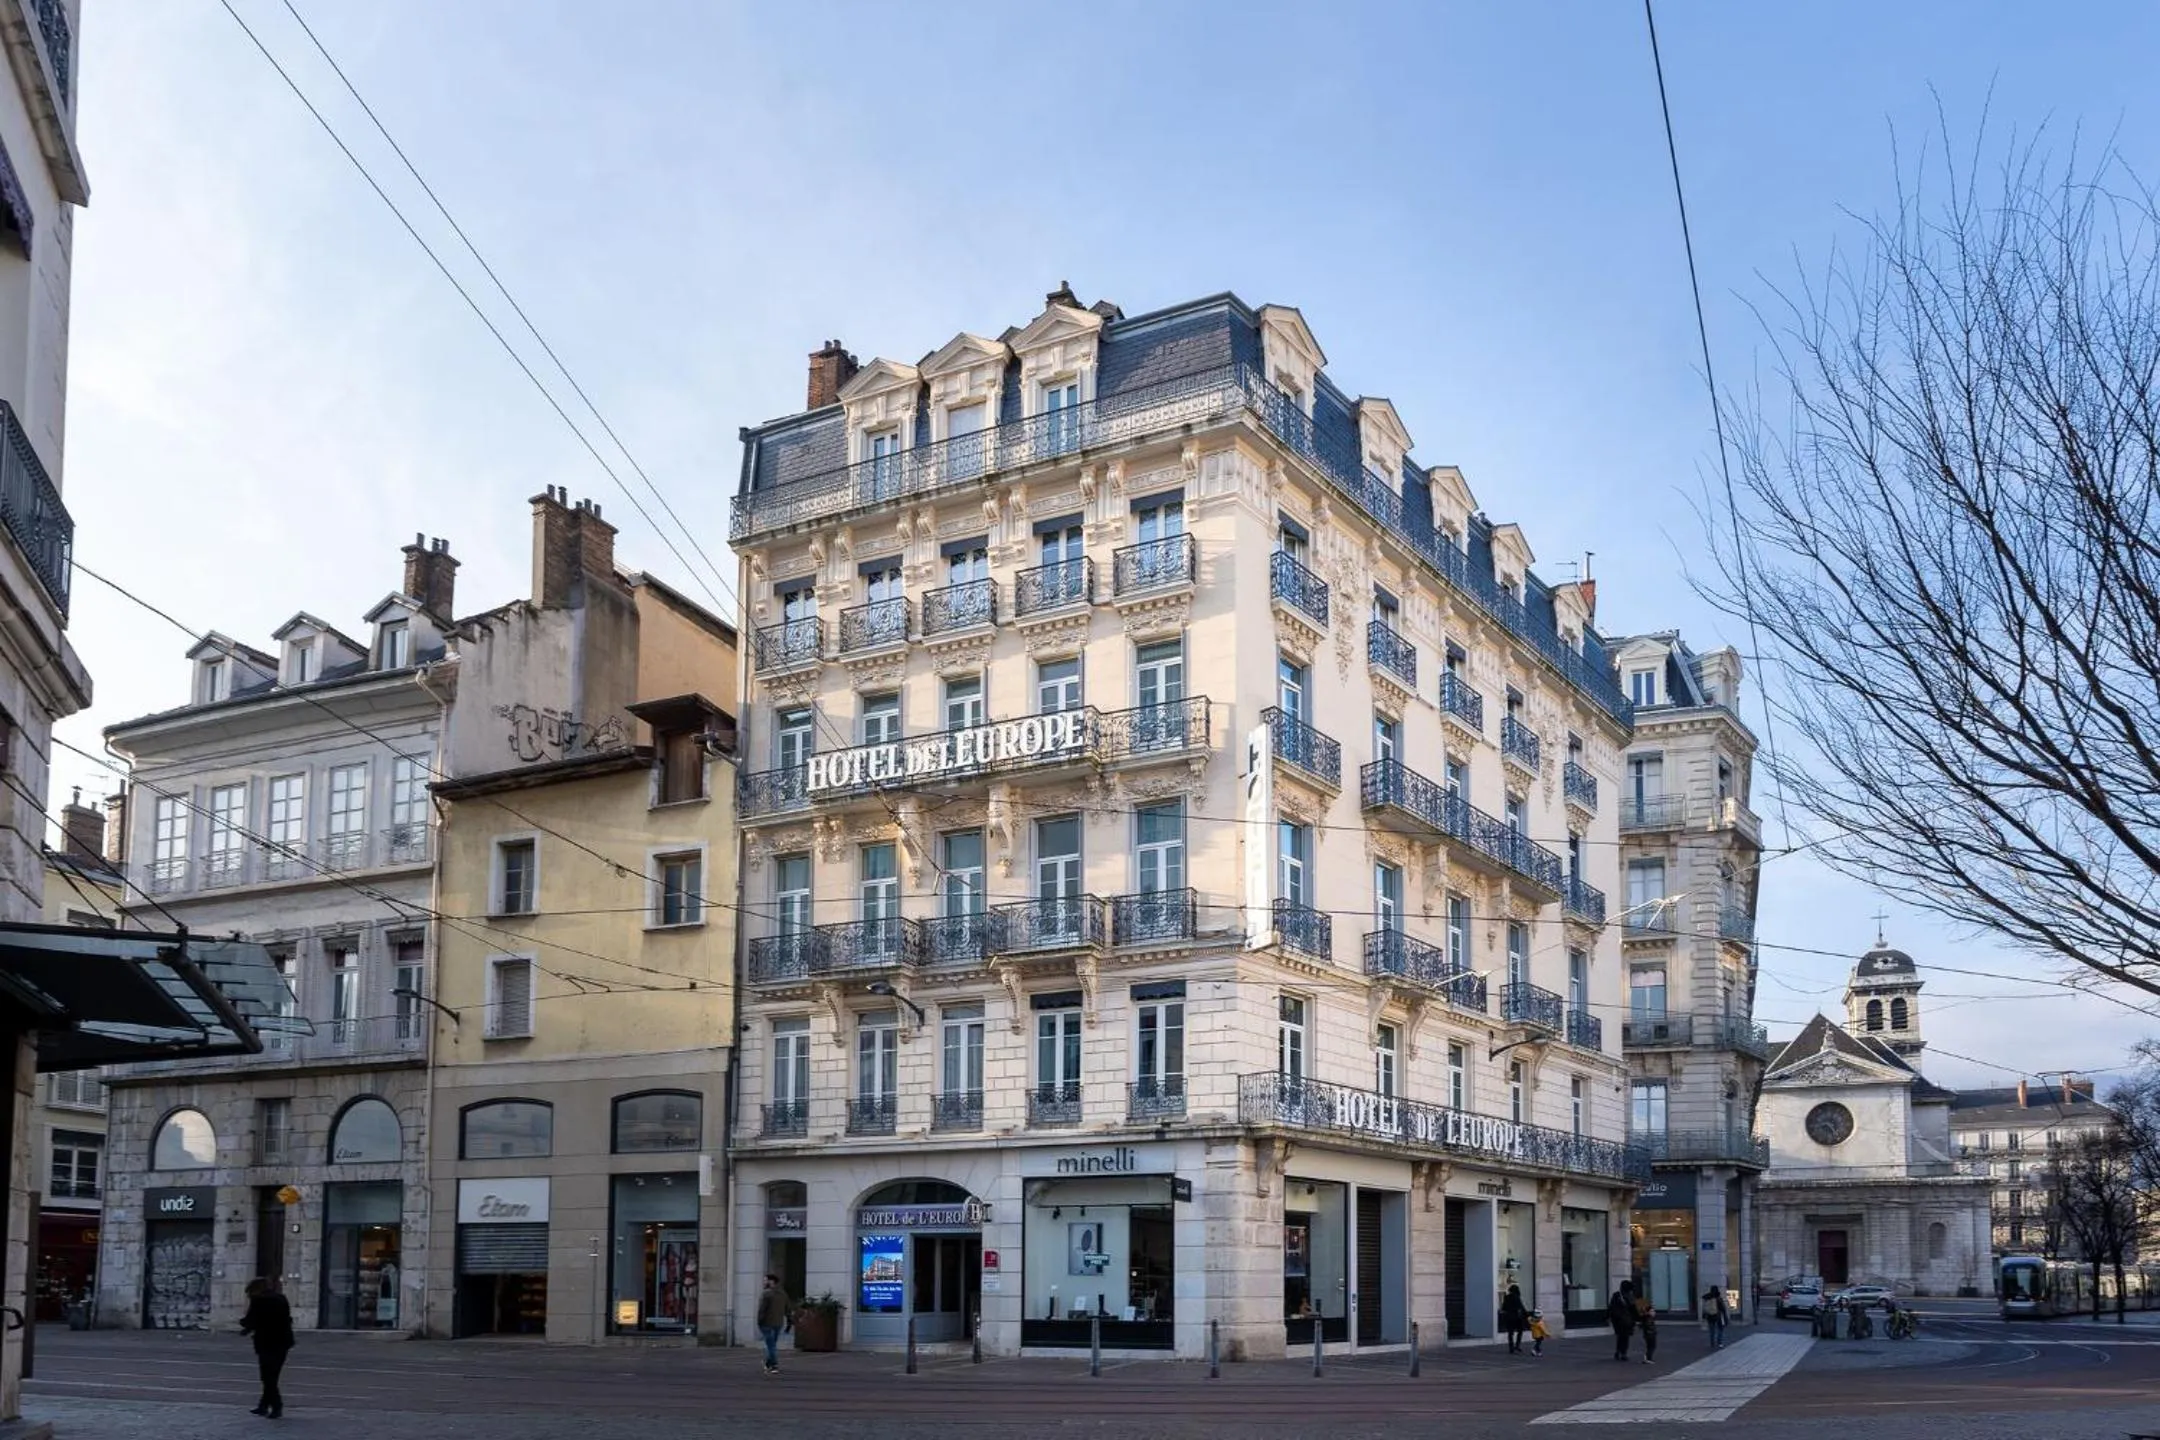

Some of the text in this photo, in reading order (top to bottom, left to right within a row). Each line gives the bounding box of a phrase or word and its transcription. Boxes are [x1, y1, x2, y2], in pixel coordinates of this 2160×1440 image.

[806, 744, 902, 792] HOTEL
[1334, 1088, 1402, 1136] HOTEL
[1416, 1112, 1437, 1142] DE
[1057, 1147, 1135, 1173] minelli
[160, 1195, 195, 1212] undiz
[477, 1195, 531, 1218] Etam
[861, 1210, 967, 1225] HOTEL de L'EURO
